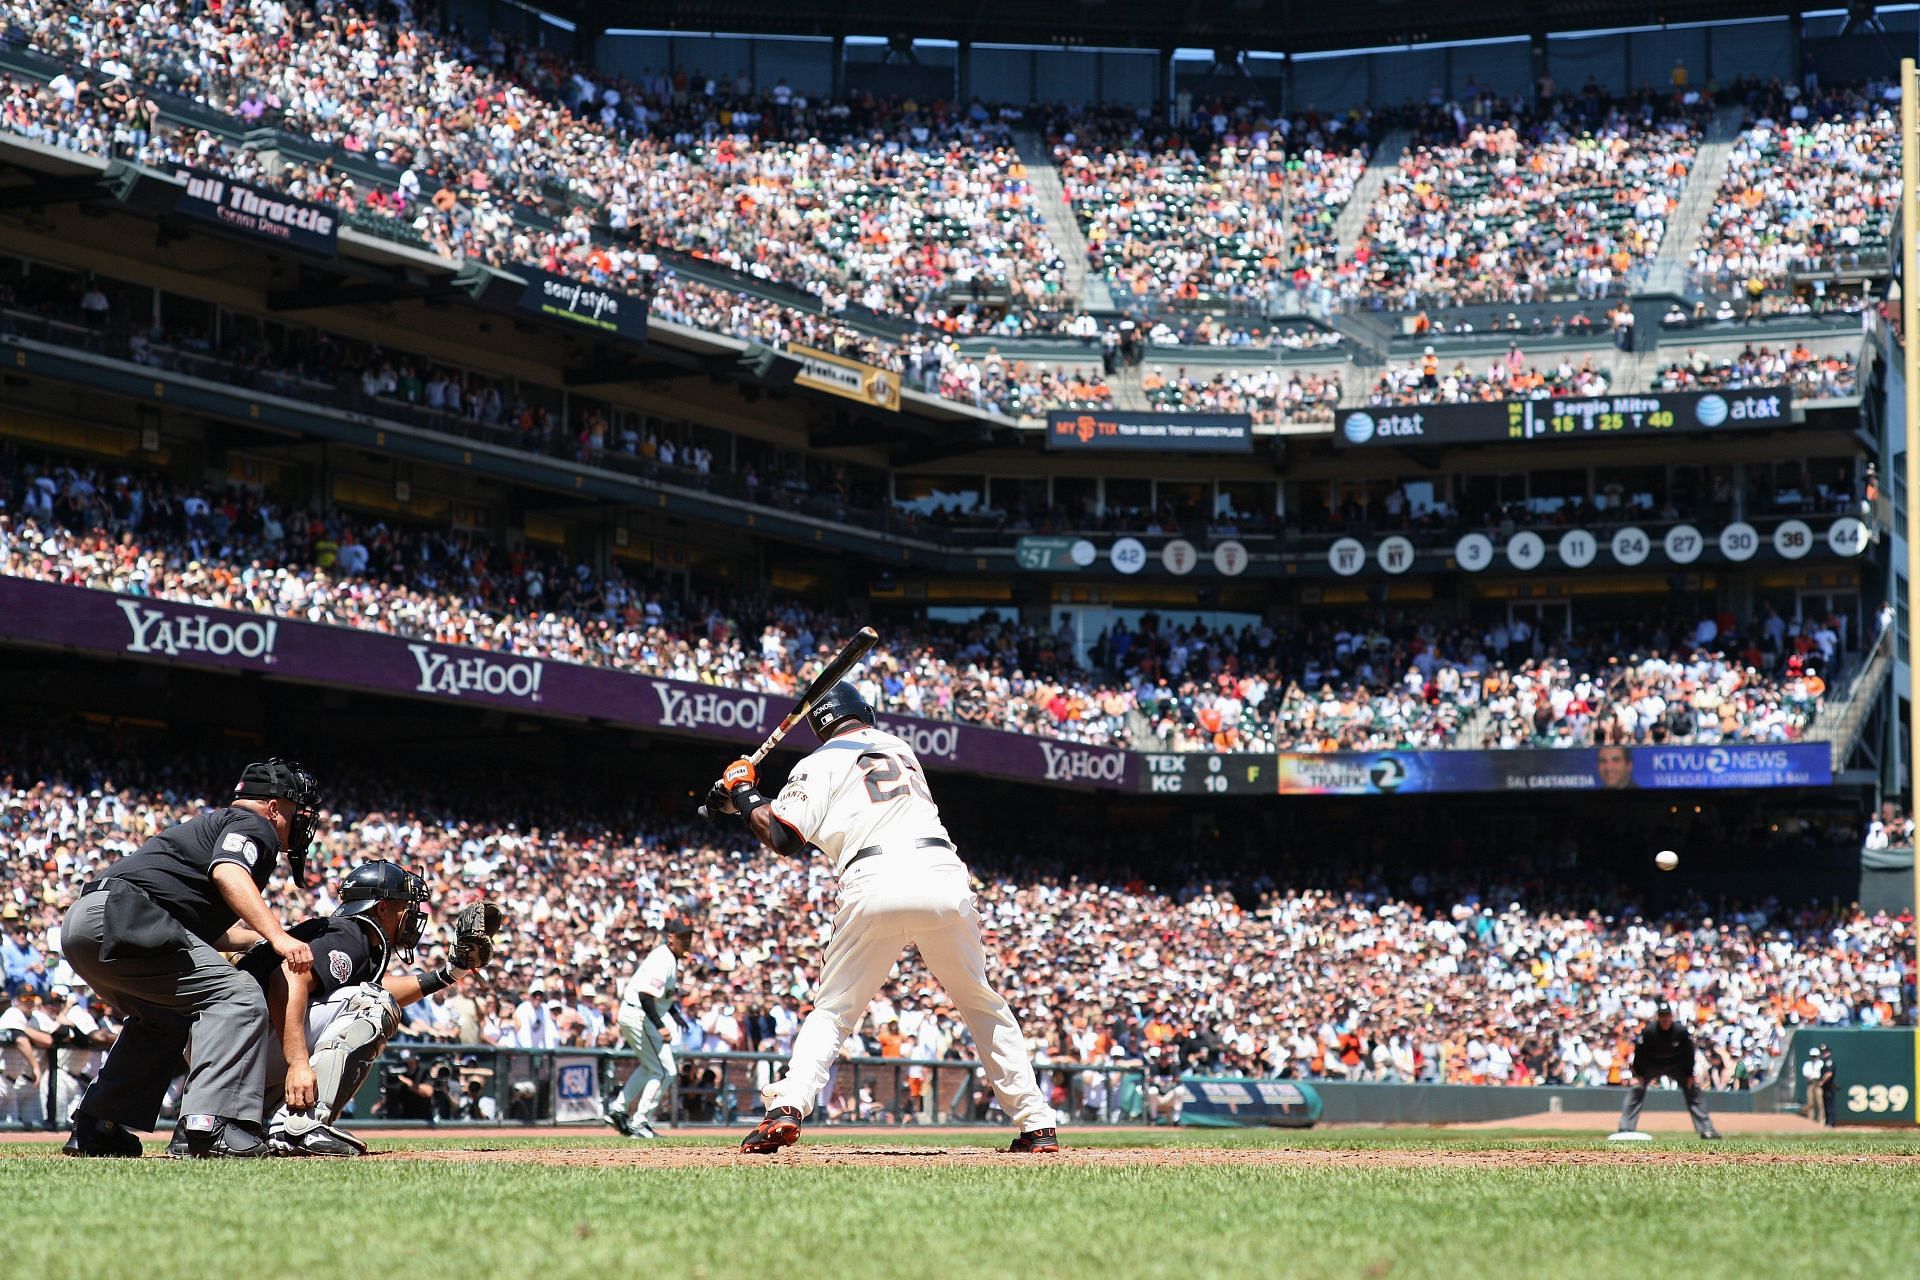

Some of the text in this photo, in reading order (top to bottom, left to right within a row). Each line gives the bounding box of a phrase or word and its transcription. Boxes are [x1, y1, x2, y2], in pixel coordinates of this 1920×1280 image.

[175, 168, 334, 236] Full Throttle
[1553, 397, 1661, 417] Sergio Mitre
[1730, 395, 1782, 419] at&t
[1055, 421, 1076, 435] MY
[1097, 421, 1118, 436] TIX
[1376, 412, 1425, 437] at&t
[1551, 416, 1575, 433] 15
[1599, 414, 1624, 431] 25
[1648, 411, 1675, 428] 40
[1672, 535, 1697, 552] 27
[1727, 533, 1752, 550] 30
[1834, 528, 1860, 545] 44
[1468, 544, 1481, 560] 3
[1519, 543, 1531, 558] 4
[1570, 541, 1585, 557] 11
[1619, 538, 1644, 555] 24
[1116, 548, 1141, 564] 42
[116, 599, 279, 664] YAHOO!
[408, 644, 543, 702] YAHOO!
[651, 681, 766, 734] YAHOO!
[813, 701, 833, 717] BONDS
[877, 721, 960, 761] HOO!
[1038, 740, 1127, 783] YAHOO!
[1145, 755, 1222, 772] TEX 0
[1652, 752, 1705, 771] KTVU
[1731, 750, 1788, 769] NEWS
[1247, 766, 1260, 783] F
[1151, 776, 1228, 792] KC 10
[1847, 1084, 1910, 1113] 339
